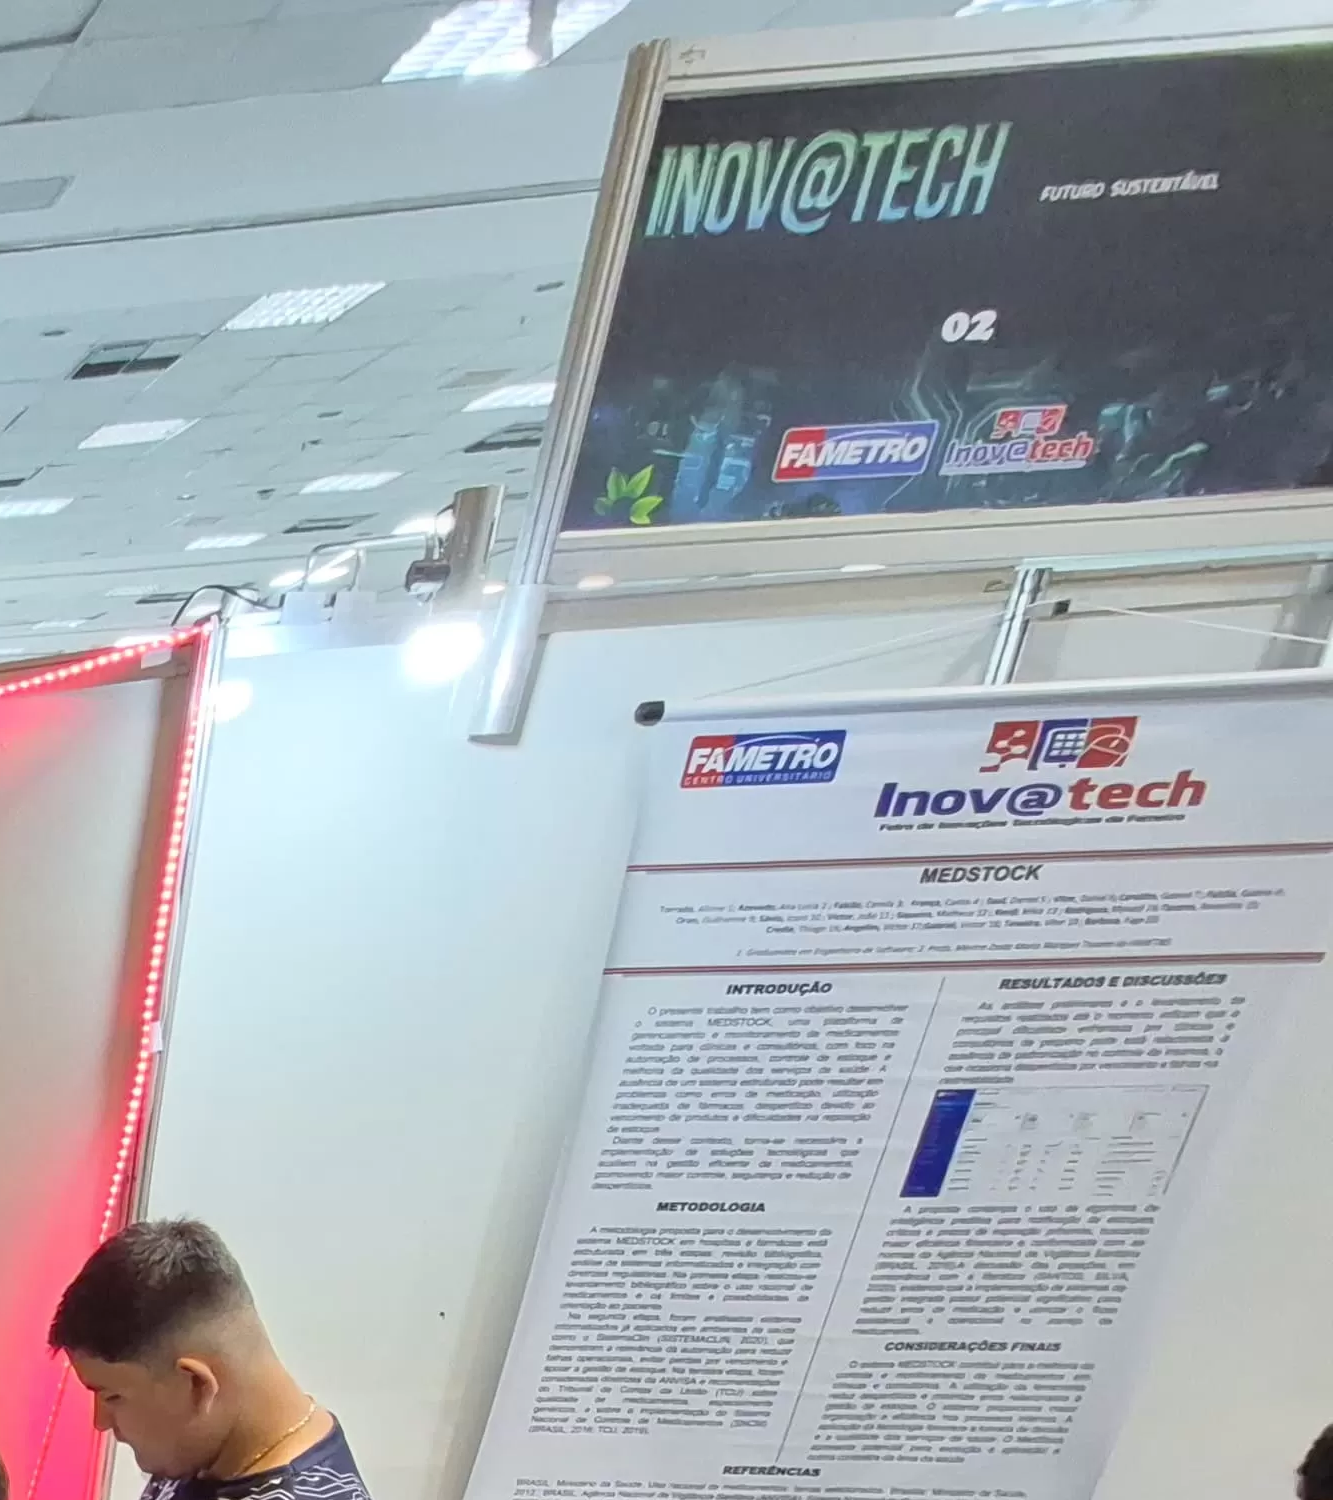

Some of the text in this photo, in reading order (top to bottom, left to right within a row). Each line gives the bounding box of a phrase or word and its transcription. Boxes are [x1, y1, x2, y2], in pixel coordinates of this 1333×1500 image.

[644, 120, 1013, 239] INOV@TECH
[1040, 170, 1219, 201] FUTURO SUSTENTÁVEL
[941, 309, 997, 343] 02
[779, 435, 928, 469] FAMETRO
[945, 433, 1094, 466] Inov@tech
[687, 741, 837, 775] FAMETRO
[874, 768, 1208, 818] Inov@tech
[920, 864, 1043, 884] MEDSTOCK
[726, 980, 833, 996] INTRODUÇÃO
[999, 972, 1228, 990] RESULTADOS E DISCUSSÕES
[656, 1200, 766, 1213] METODOLOGIA
[884, 1340, 1062, 1353] CONSIDERAÇÕES FINAIS
[722, 1465, 821, 1477] REFERÊNCIAS
